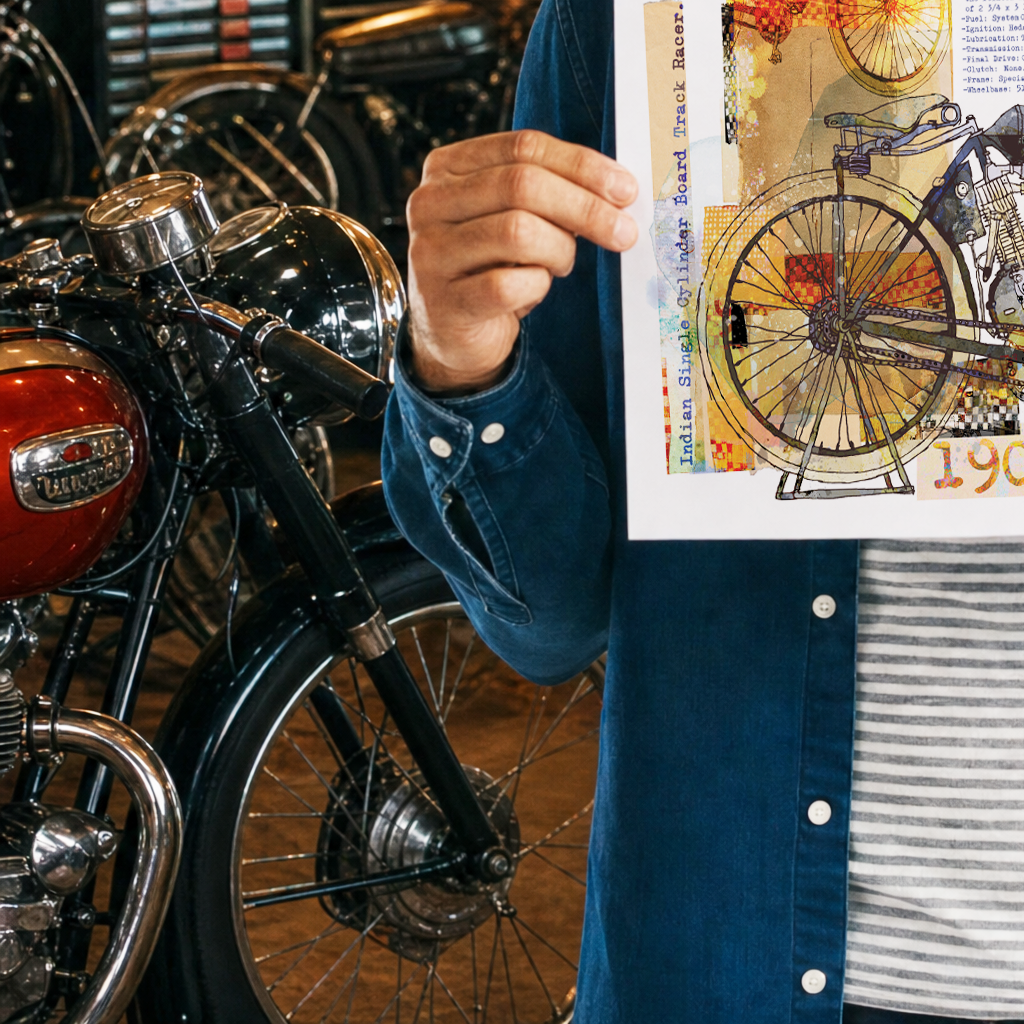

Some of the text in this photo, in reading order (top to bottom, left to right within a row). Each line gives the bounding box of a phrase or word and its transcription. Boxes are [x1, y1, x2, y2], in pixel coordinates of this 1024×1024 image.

[961, 15, 987, 23] -Fuel:
[962, 25, 1005, 33] -Ignition:
[962, 55, 989, 63] -Final
[963, 86, 1010, 94] -Wheelbase:
[671, 3, 694, 466] Indian Single Cylinder Board Track Racer.
